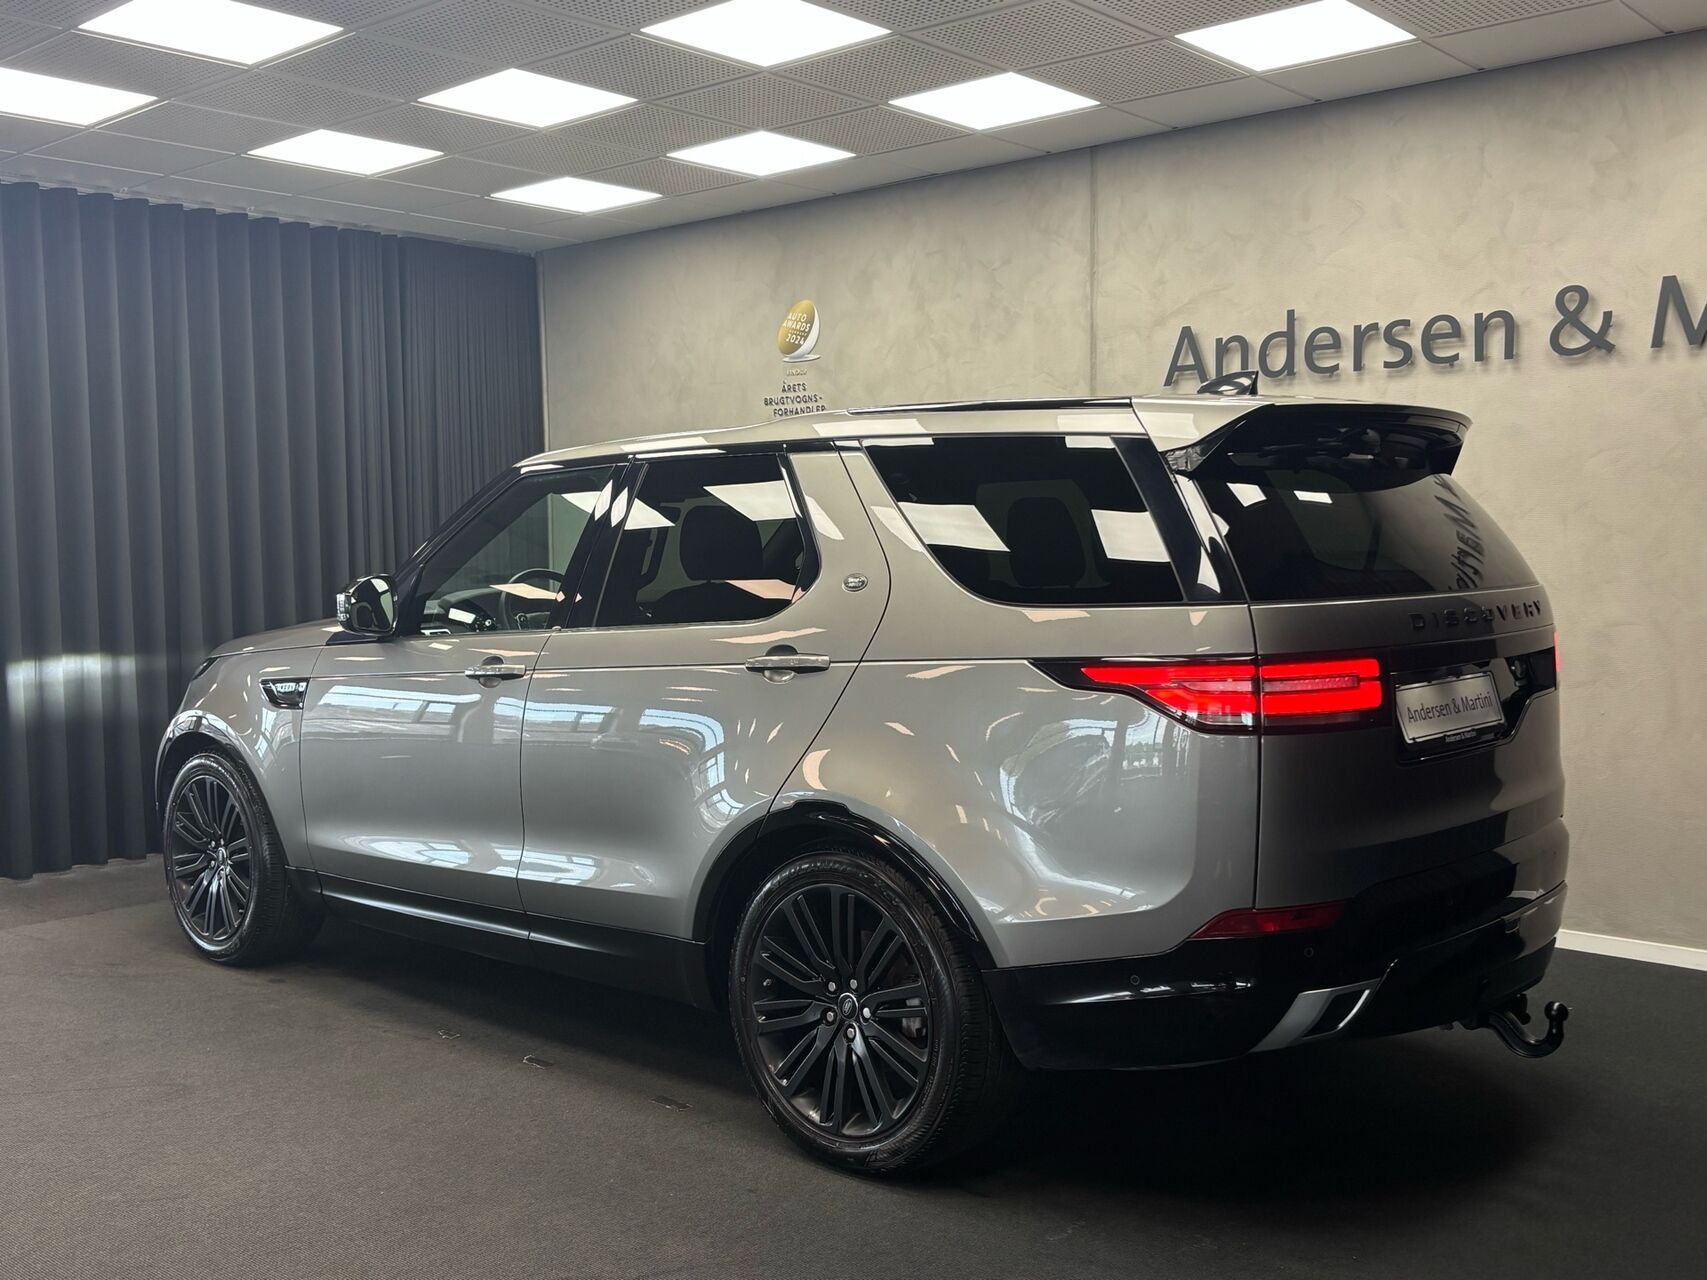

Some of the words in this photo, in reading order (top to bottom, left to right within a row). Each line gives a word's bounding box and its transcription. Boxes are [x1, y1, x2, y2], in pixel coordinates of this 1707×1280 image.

[788, 312, 807, 322] AUTO
[783, 319, 811, 332] AWARDS
[786, 333, 805, 345] 2024
[1163, 309, 1515, 386] Andersen
[1549, 284, 1616, 356] &
[781, 380, 807, 393] ÅRETS
[763, 393, 823, 406] BRUGTVOGNS-
[1408, 600, 1541, 631] DISCOVERY
[1407, 702, 1452, 723] Andersen
[1452, 698, 1461, 714] &
[1461, 691, 1493, 712] Martini
